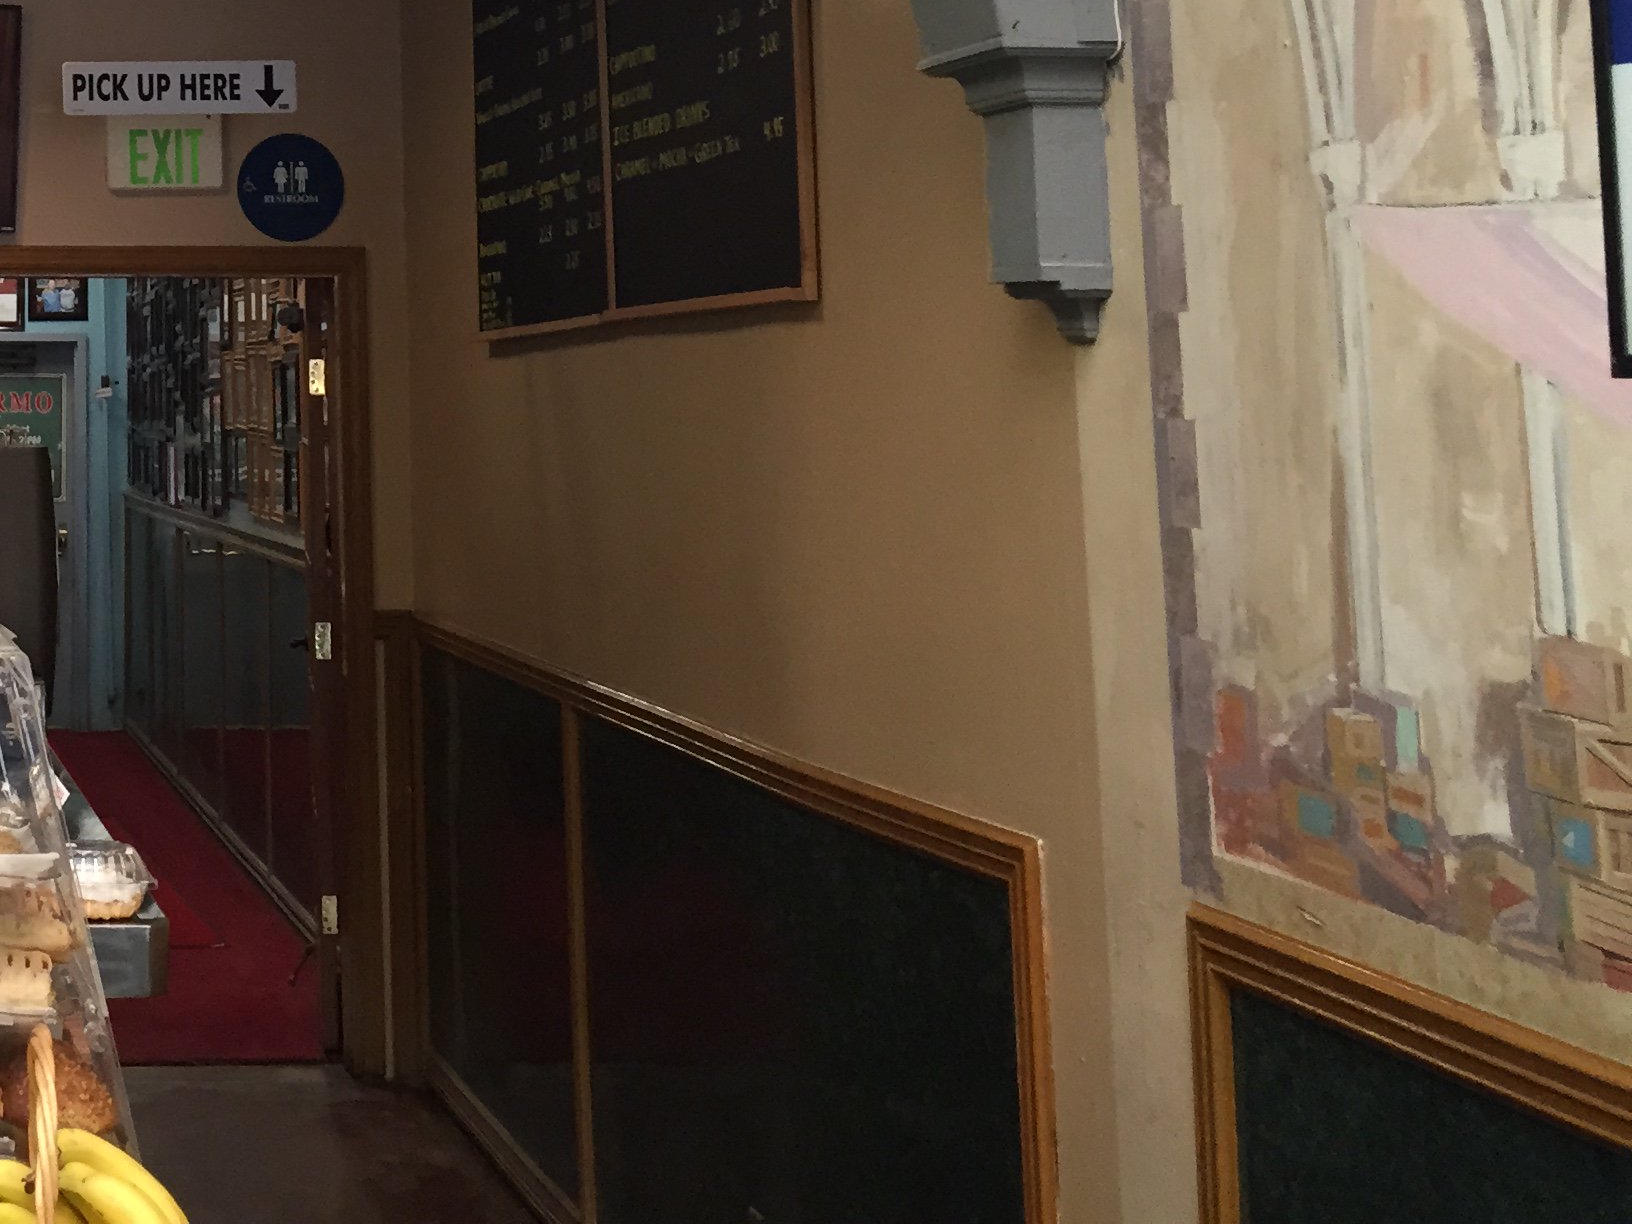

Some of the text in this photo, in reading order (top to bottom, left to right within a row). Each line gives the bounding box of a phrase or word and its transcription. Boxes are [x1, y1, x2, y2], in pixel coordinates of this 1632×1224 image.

[72, 73, 241, 102] PICK UP HERE
[128, 129, 204, 185] EXIT
[264, 194, 319, 204] RESTROOM
